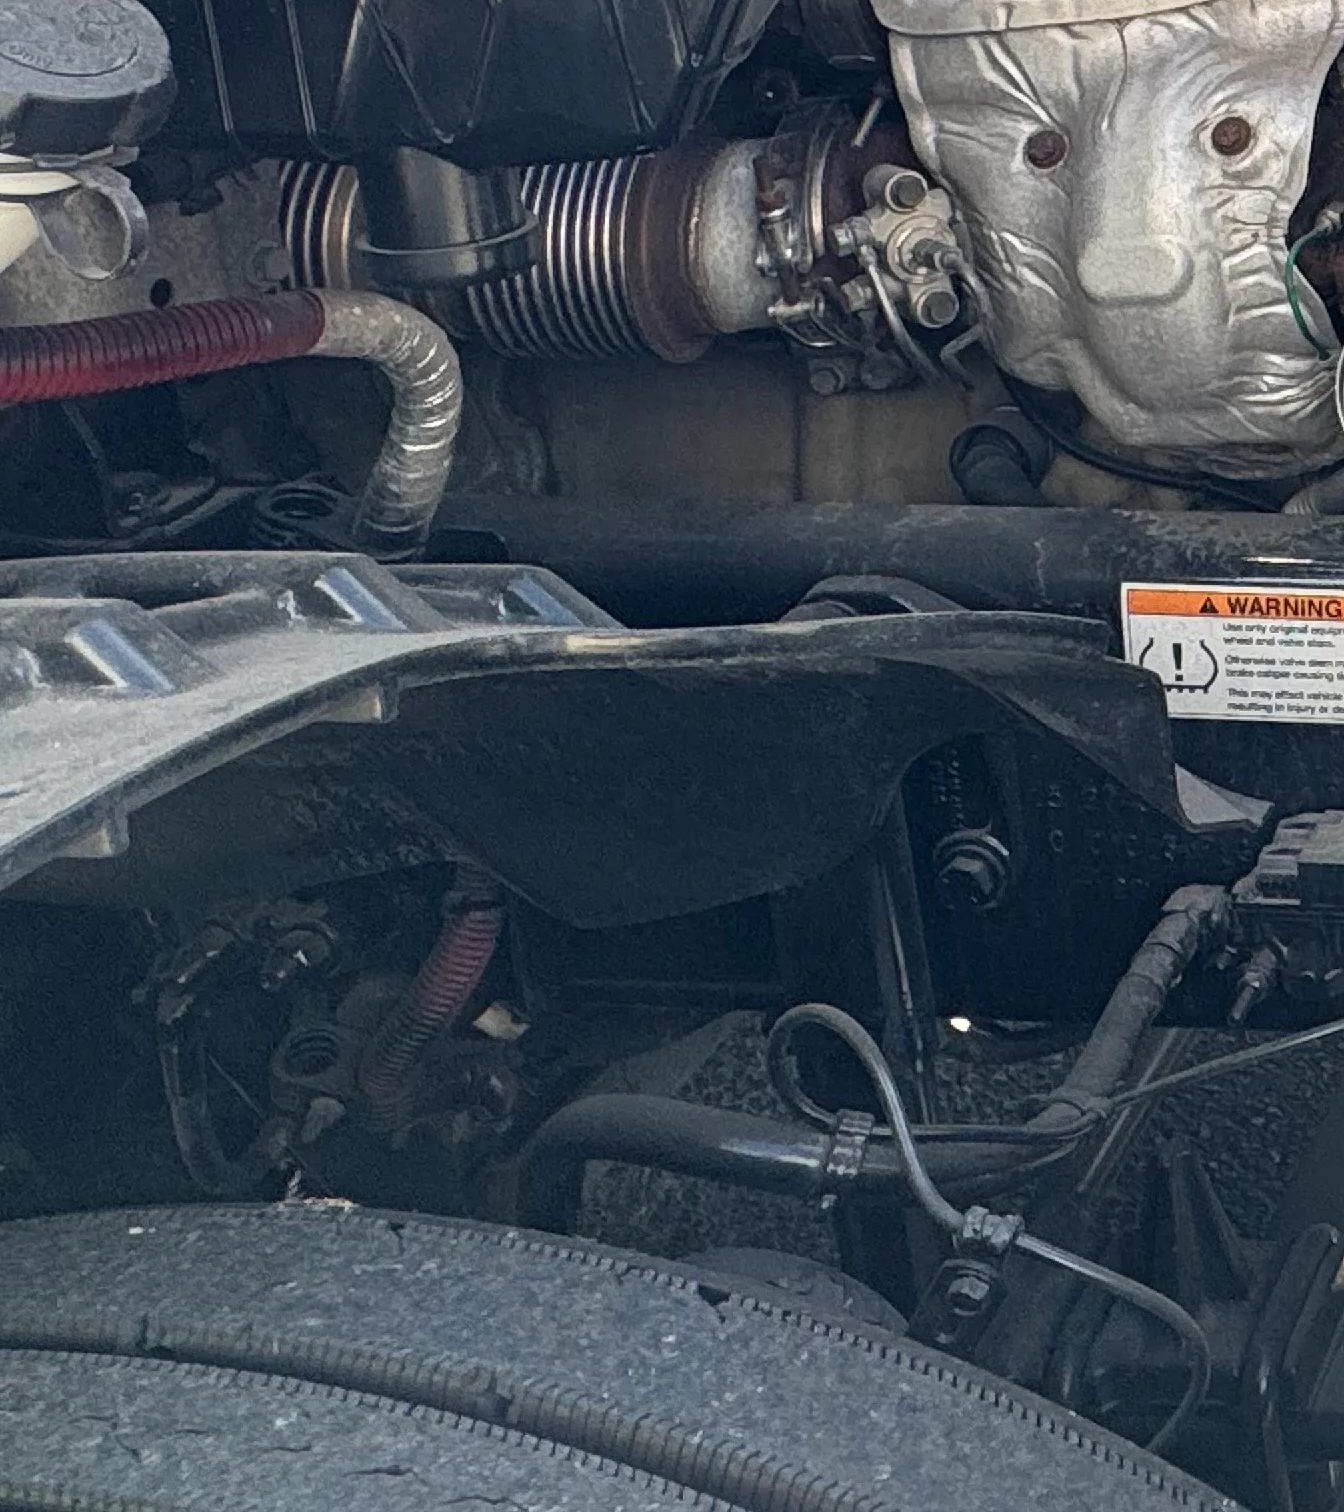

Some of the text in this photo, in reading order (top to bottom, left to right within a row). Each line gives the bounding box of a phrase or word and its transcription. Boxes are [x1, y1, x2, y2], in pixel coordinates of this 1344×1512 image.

[1227, 596, 1343, 618] WARNING
[1223, 623, 1243, 632] Use
[1245, 624, 1267, 634] only
[1269, 624, 1309, 636] original
[1293, 671, 1334, 682] causing
[1228, 688, 1249, 697] This
[1251, 690, 1273, 700] may
[1275, 703, 1285, 712] in
[1287, 703, 1315, 715] injury
[1318, 705, 1328, 713] or
